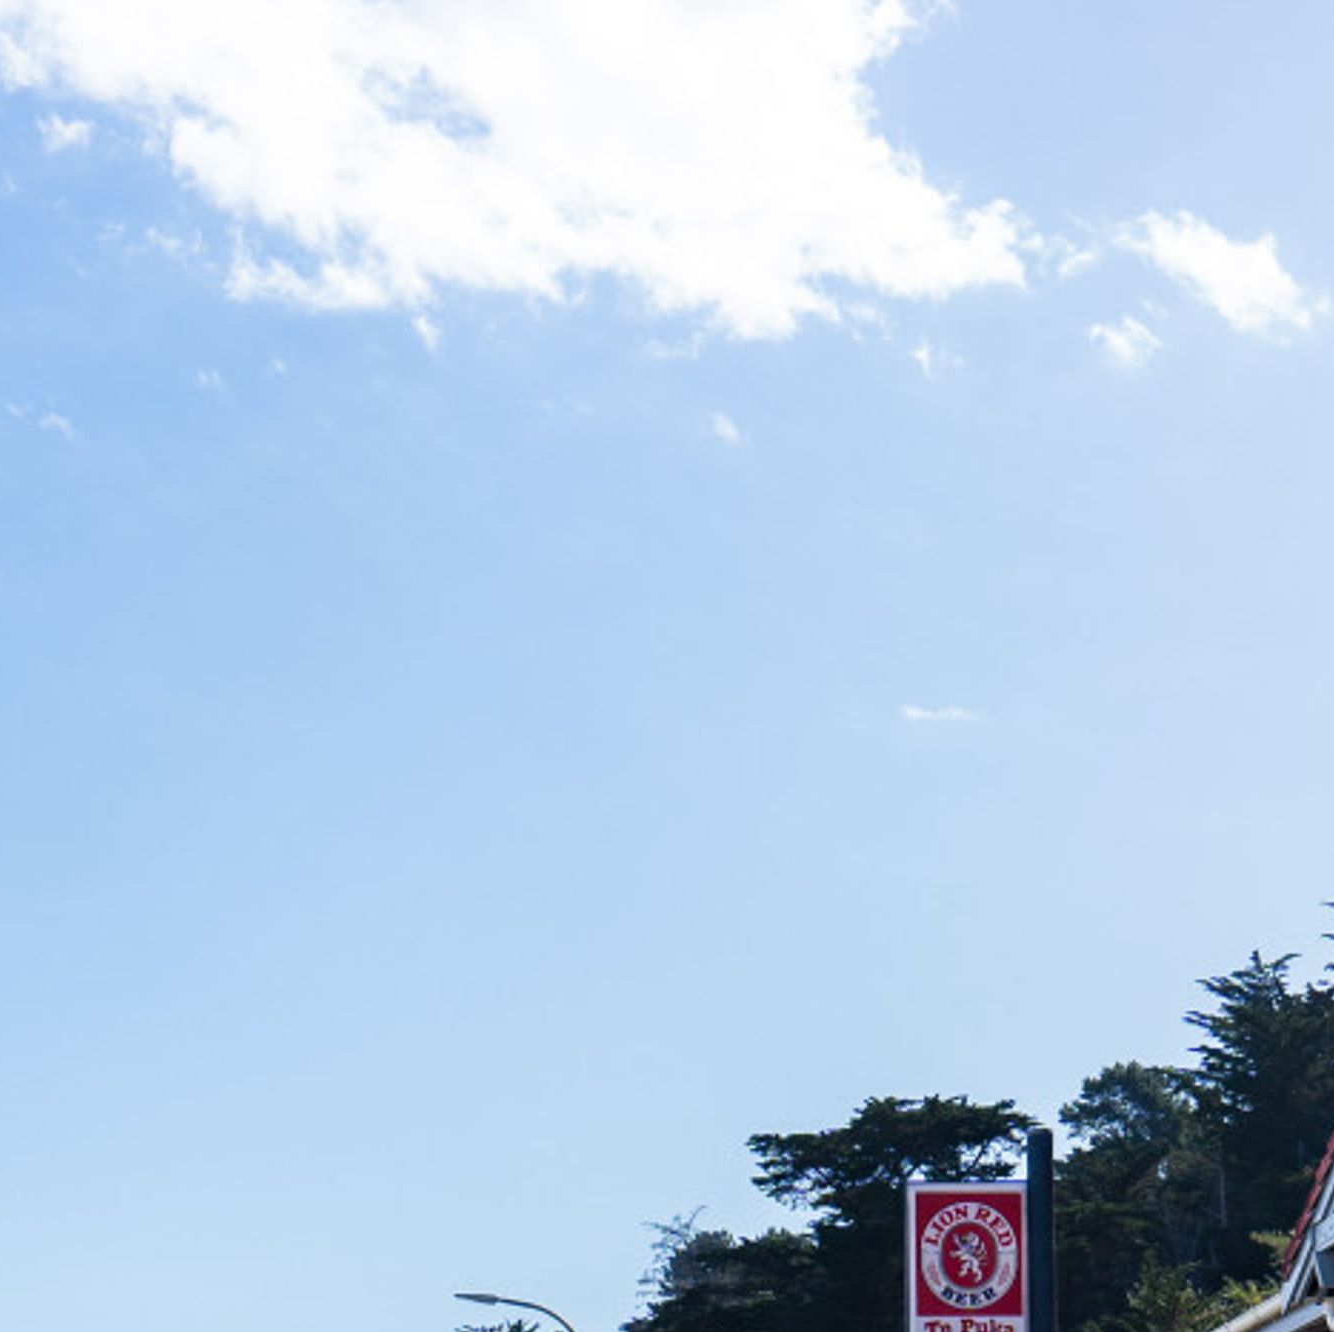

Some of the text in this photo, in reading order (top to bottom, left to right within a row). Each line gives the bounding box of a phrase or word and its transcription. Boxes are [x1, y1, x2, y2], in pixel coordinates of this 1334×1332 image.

[924, 1205, 1014, 1247] LION RED
[941, 1286, 997, 1306] BEER
